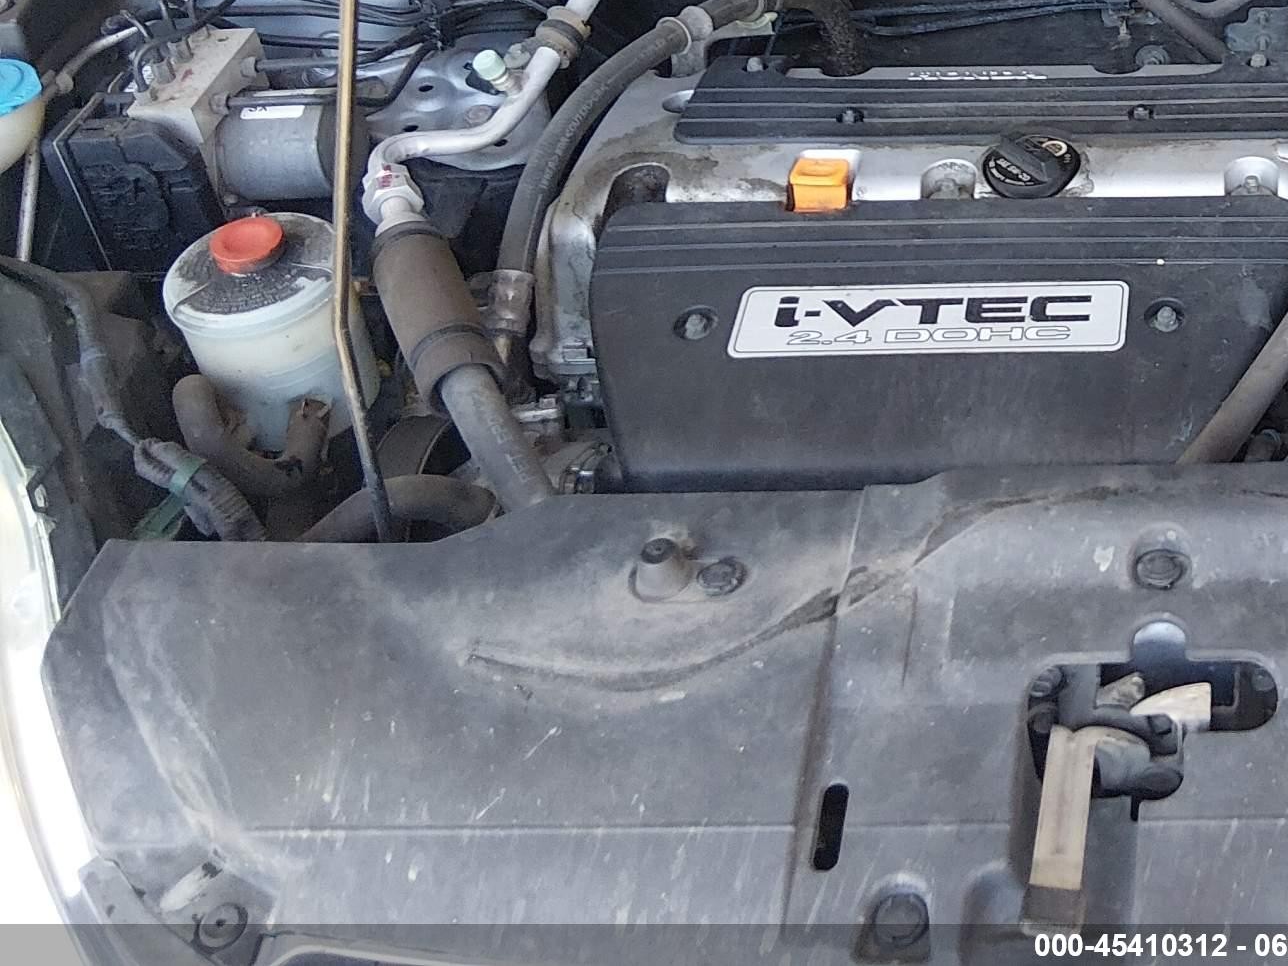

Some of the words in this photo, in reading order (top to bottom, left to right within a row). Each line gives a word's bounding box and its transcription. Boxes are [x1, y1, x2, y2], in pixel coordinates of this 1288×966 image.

[774, 295, 1093, 328] i-VTEC
[786, 329, 872, 346] 2.4
[884, 325, 1071, 344] DOHC
